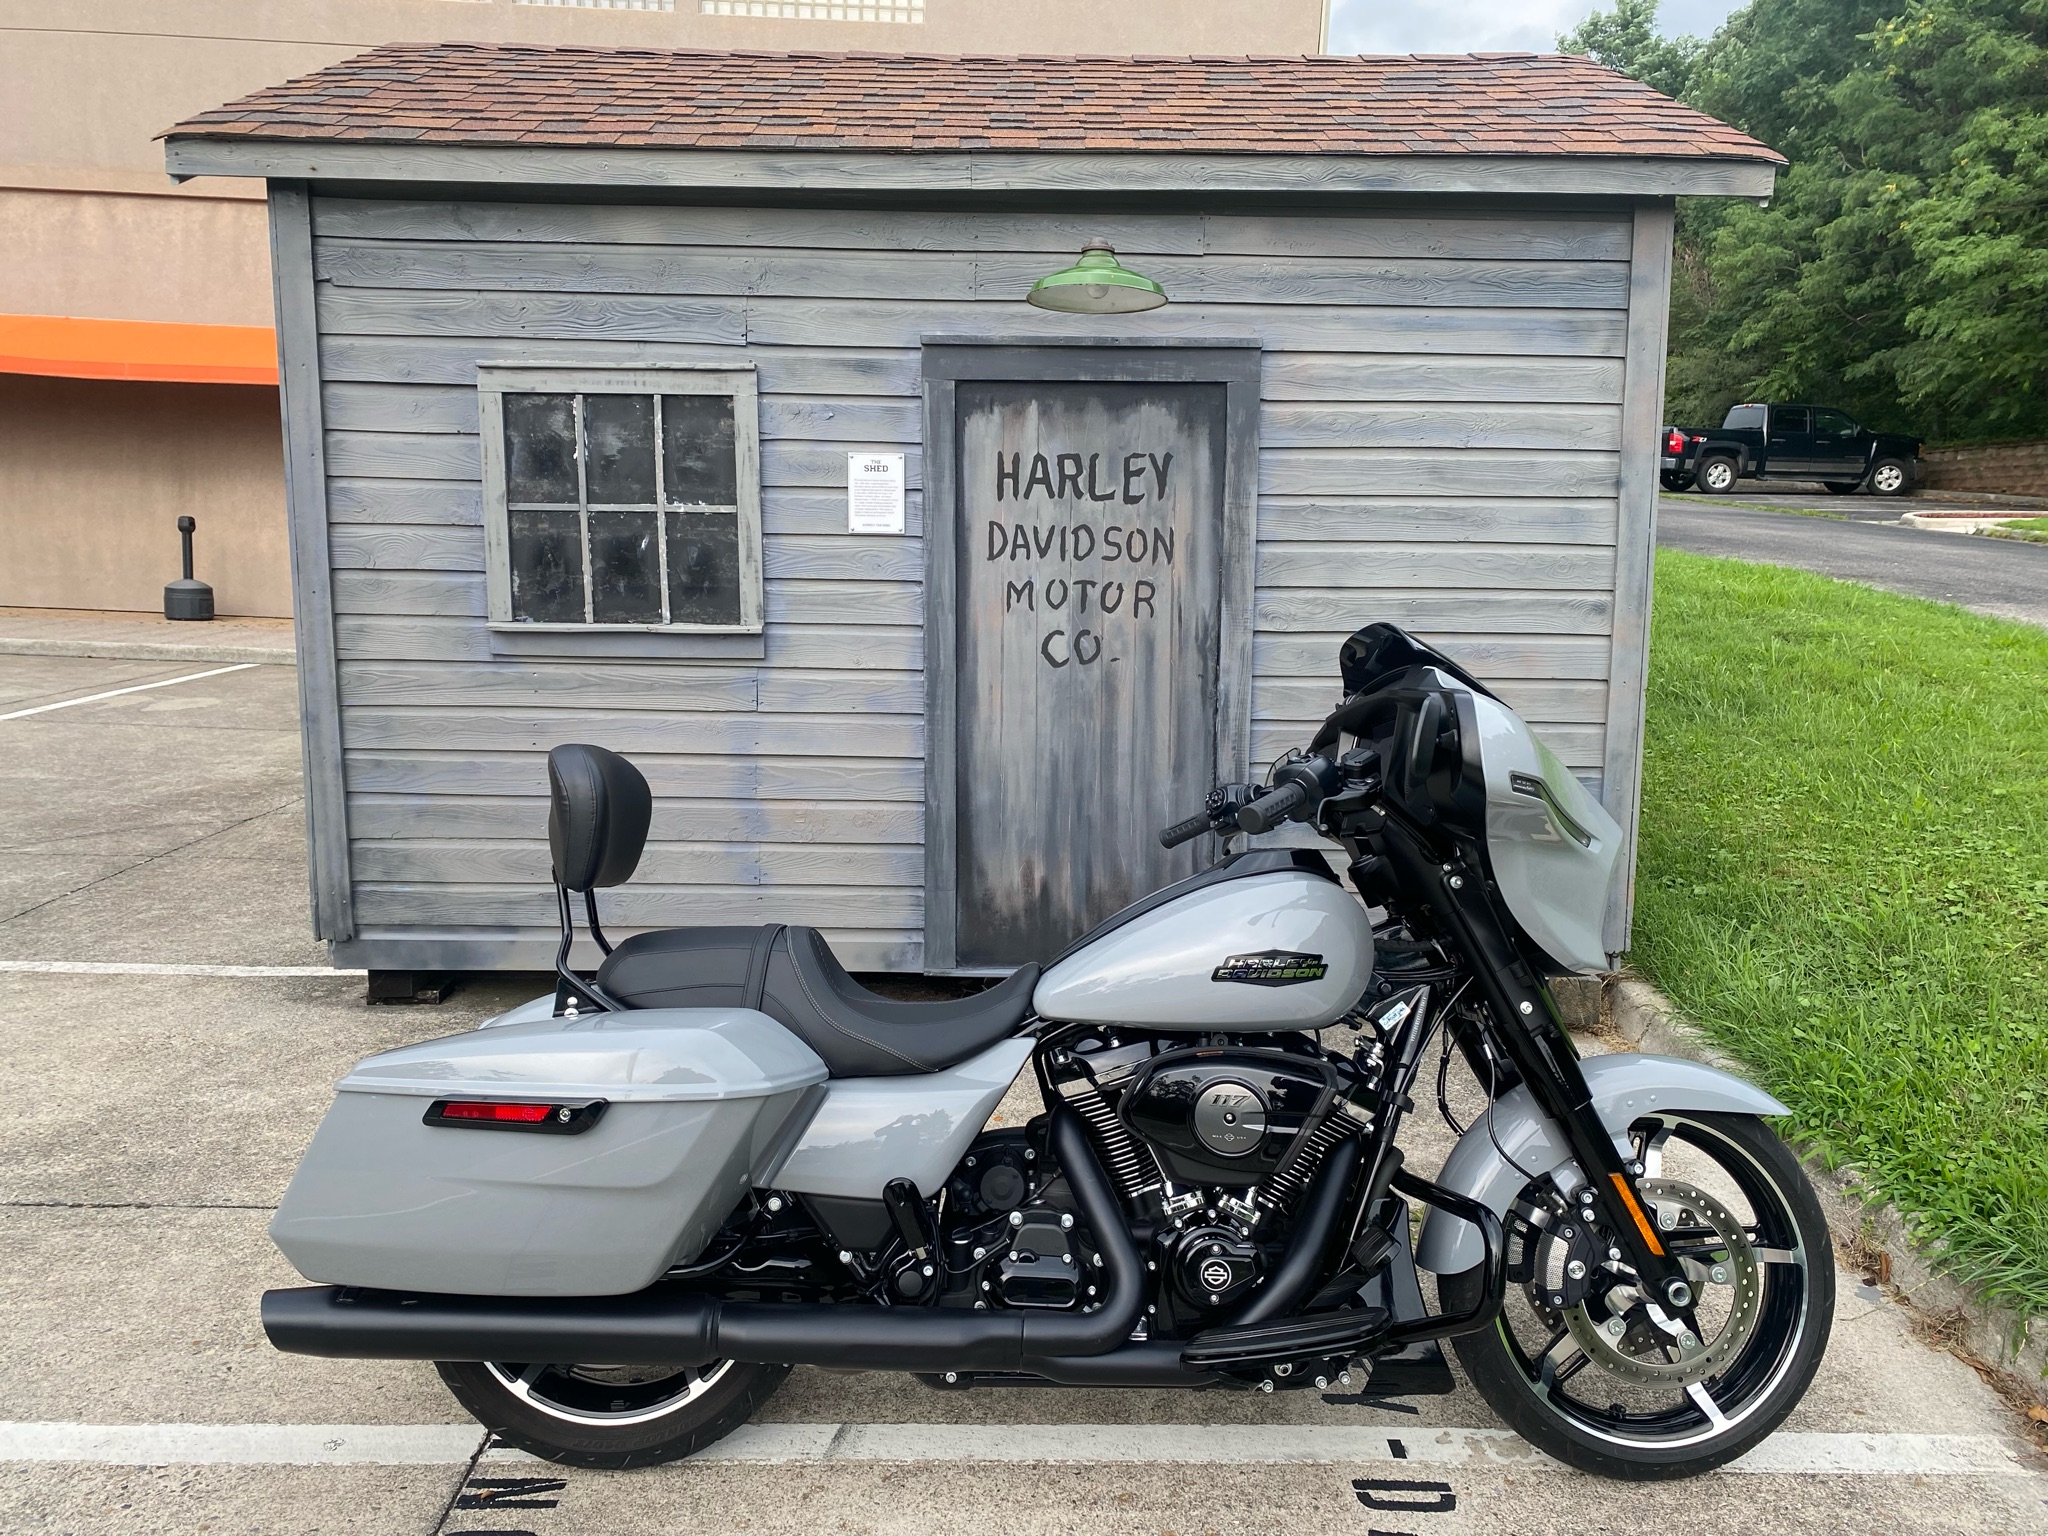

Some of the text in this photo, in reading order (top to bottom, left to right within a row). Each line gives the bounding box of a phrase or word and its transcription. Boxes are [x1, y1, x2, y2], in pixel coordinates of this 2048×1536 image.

[996, 451, 1174, 505] HARLEY
[987, 520, 1175, 566] DAVIDSON
[1006, 579, 1157, 619] MOTOR
[1217, 967, 1324, 979] DAVIDSON
[1210, 1093, 1251, 1108] 117
